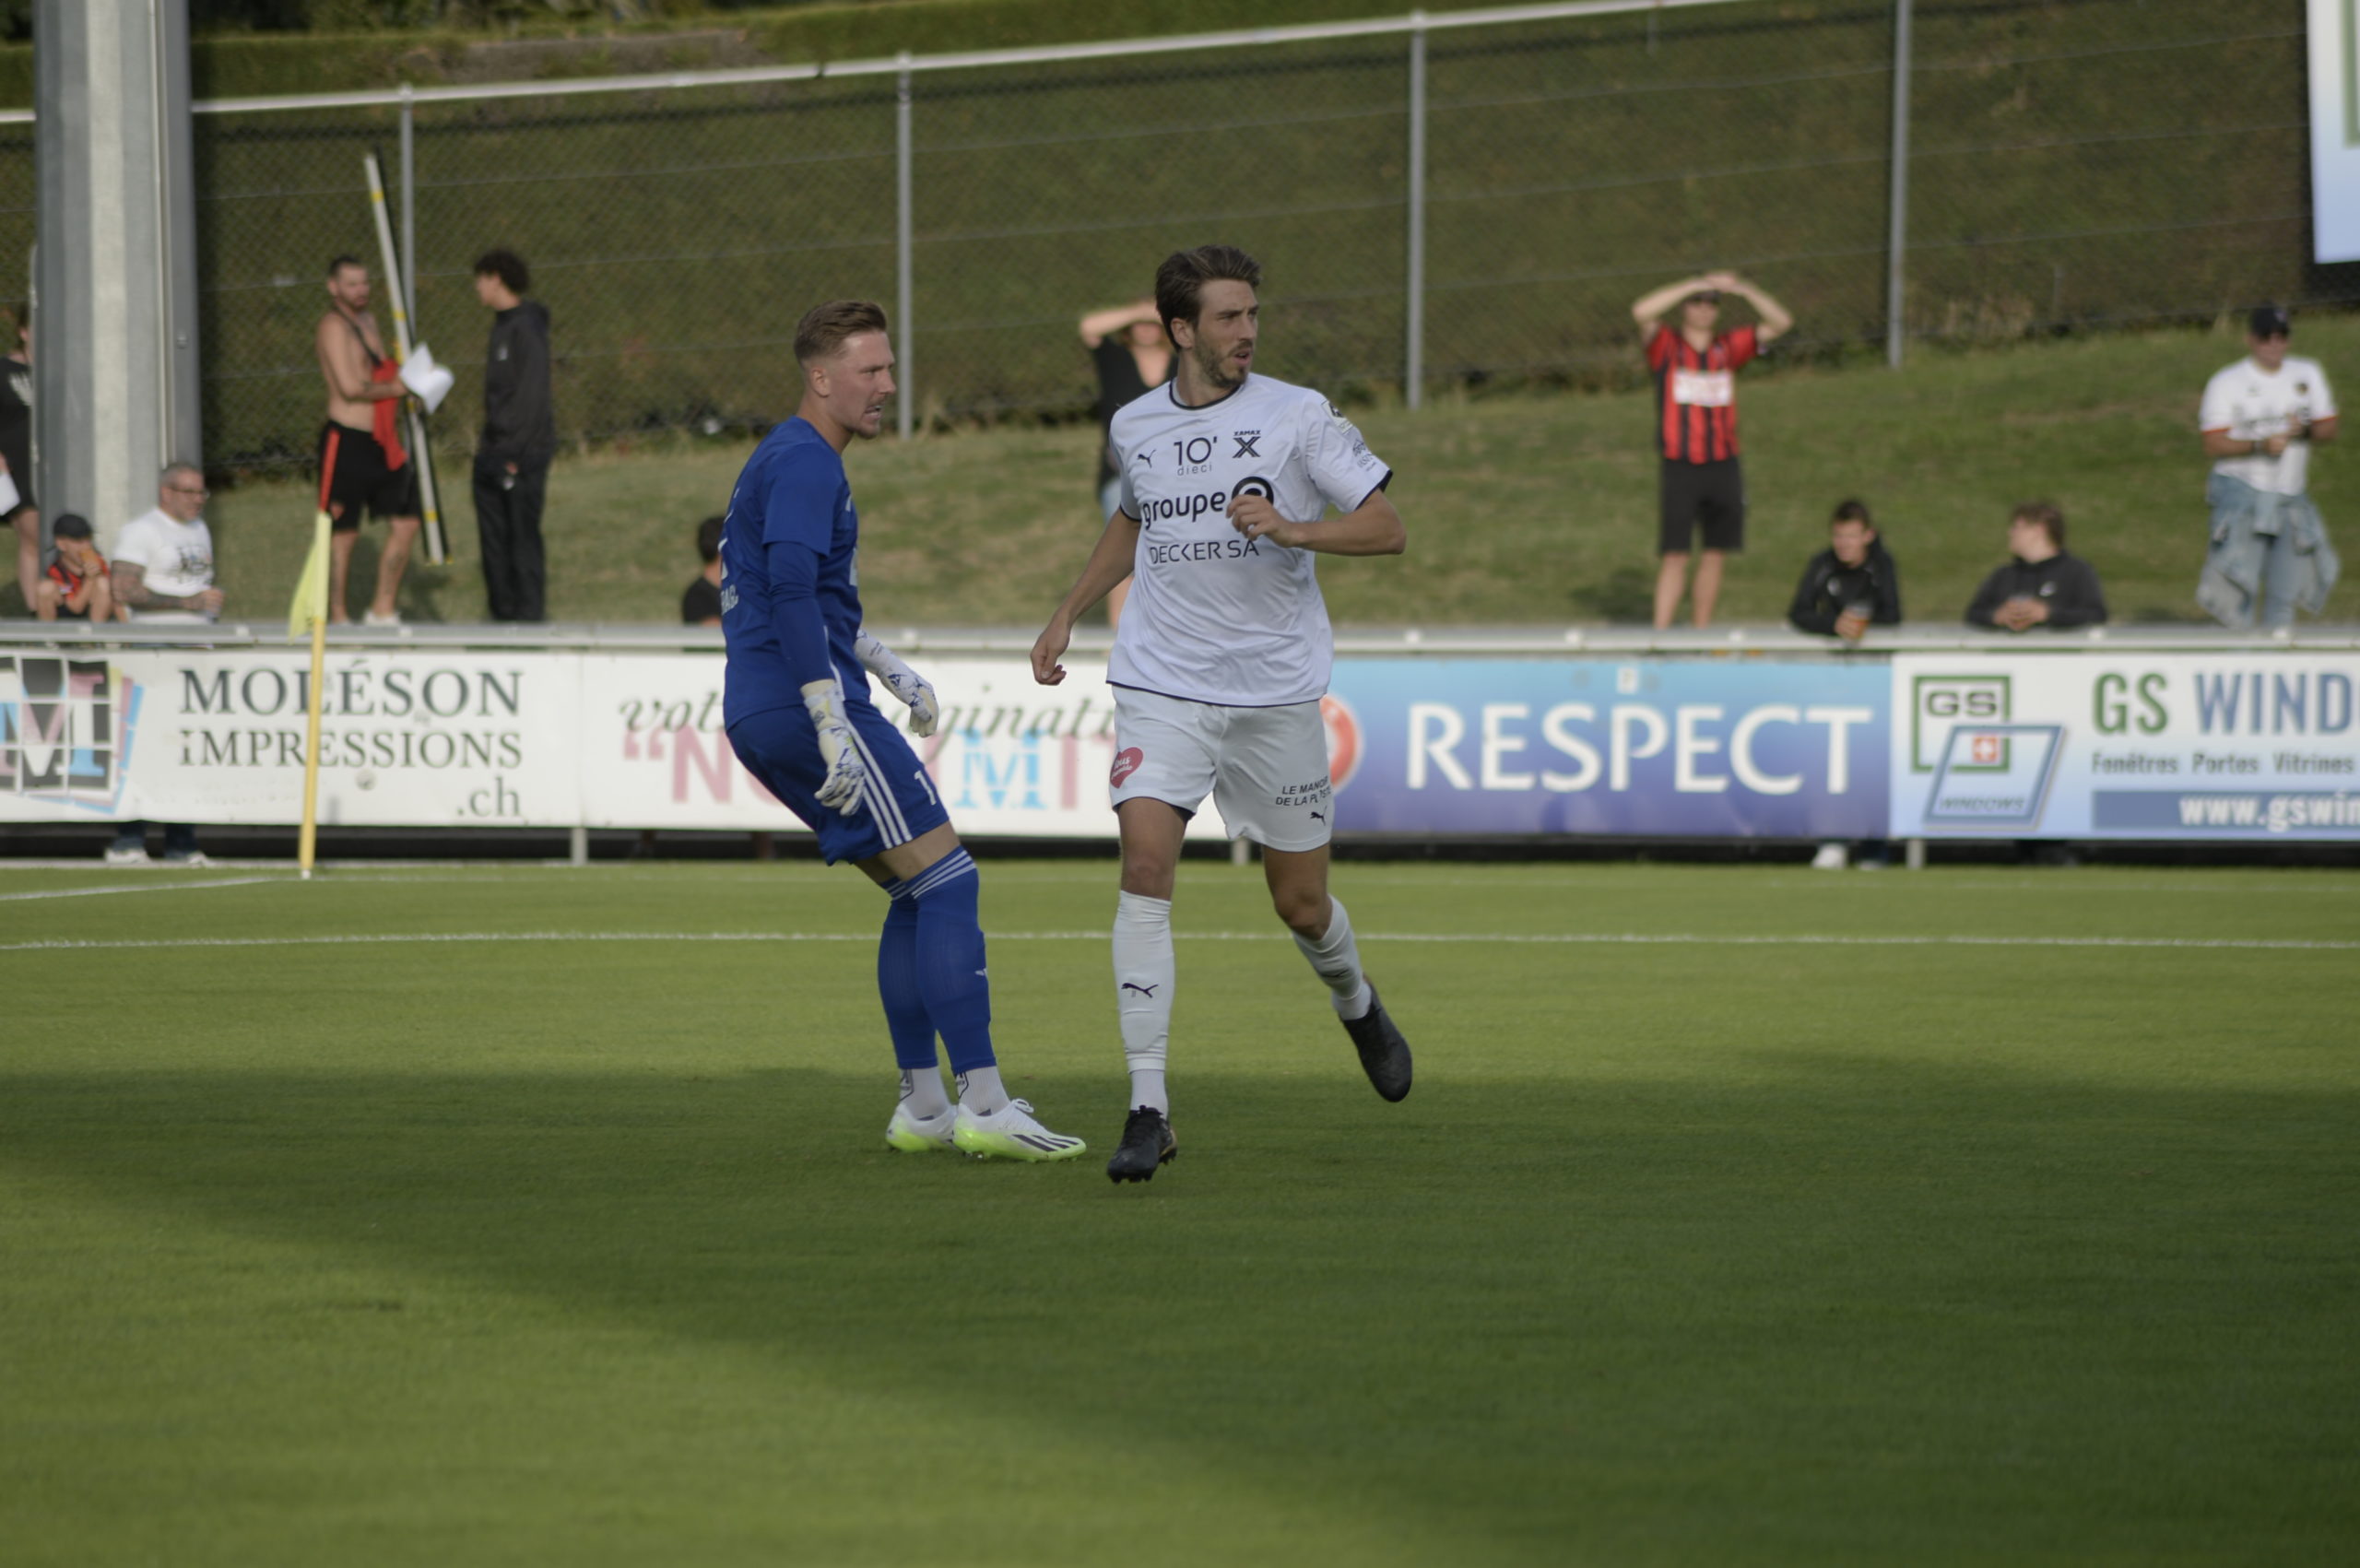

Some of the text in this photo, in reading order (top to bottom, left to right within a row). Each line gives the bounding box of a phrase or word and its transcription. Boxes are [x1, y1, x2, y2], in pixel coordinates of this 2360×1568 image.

[1176, 464, 1213, 477] dieci
[1142, 491, 1226, 531] groupe
[1150, 539, 1260, 565] DECKER SA
[179, 654, 525, 717] MOLÉSON
[1927, 691, 1998, 716] GS
[2093, 671, 2360, 736] GS WIND
[1406, 701, 1873, 795] RESPECT
[2091, 751, 2355, 774] Fenêtres Portes Vitrines
[457, 776, 521, 817] .ch
[1275, 796, 1291, 807] DE
[1293, 796, 1308, 807] LA
[1281, 785, 1298, 795] LE
[1940, 797, 2026, 810] WINDOWS
